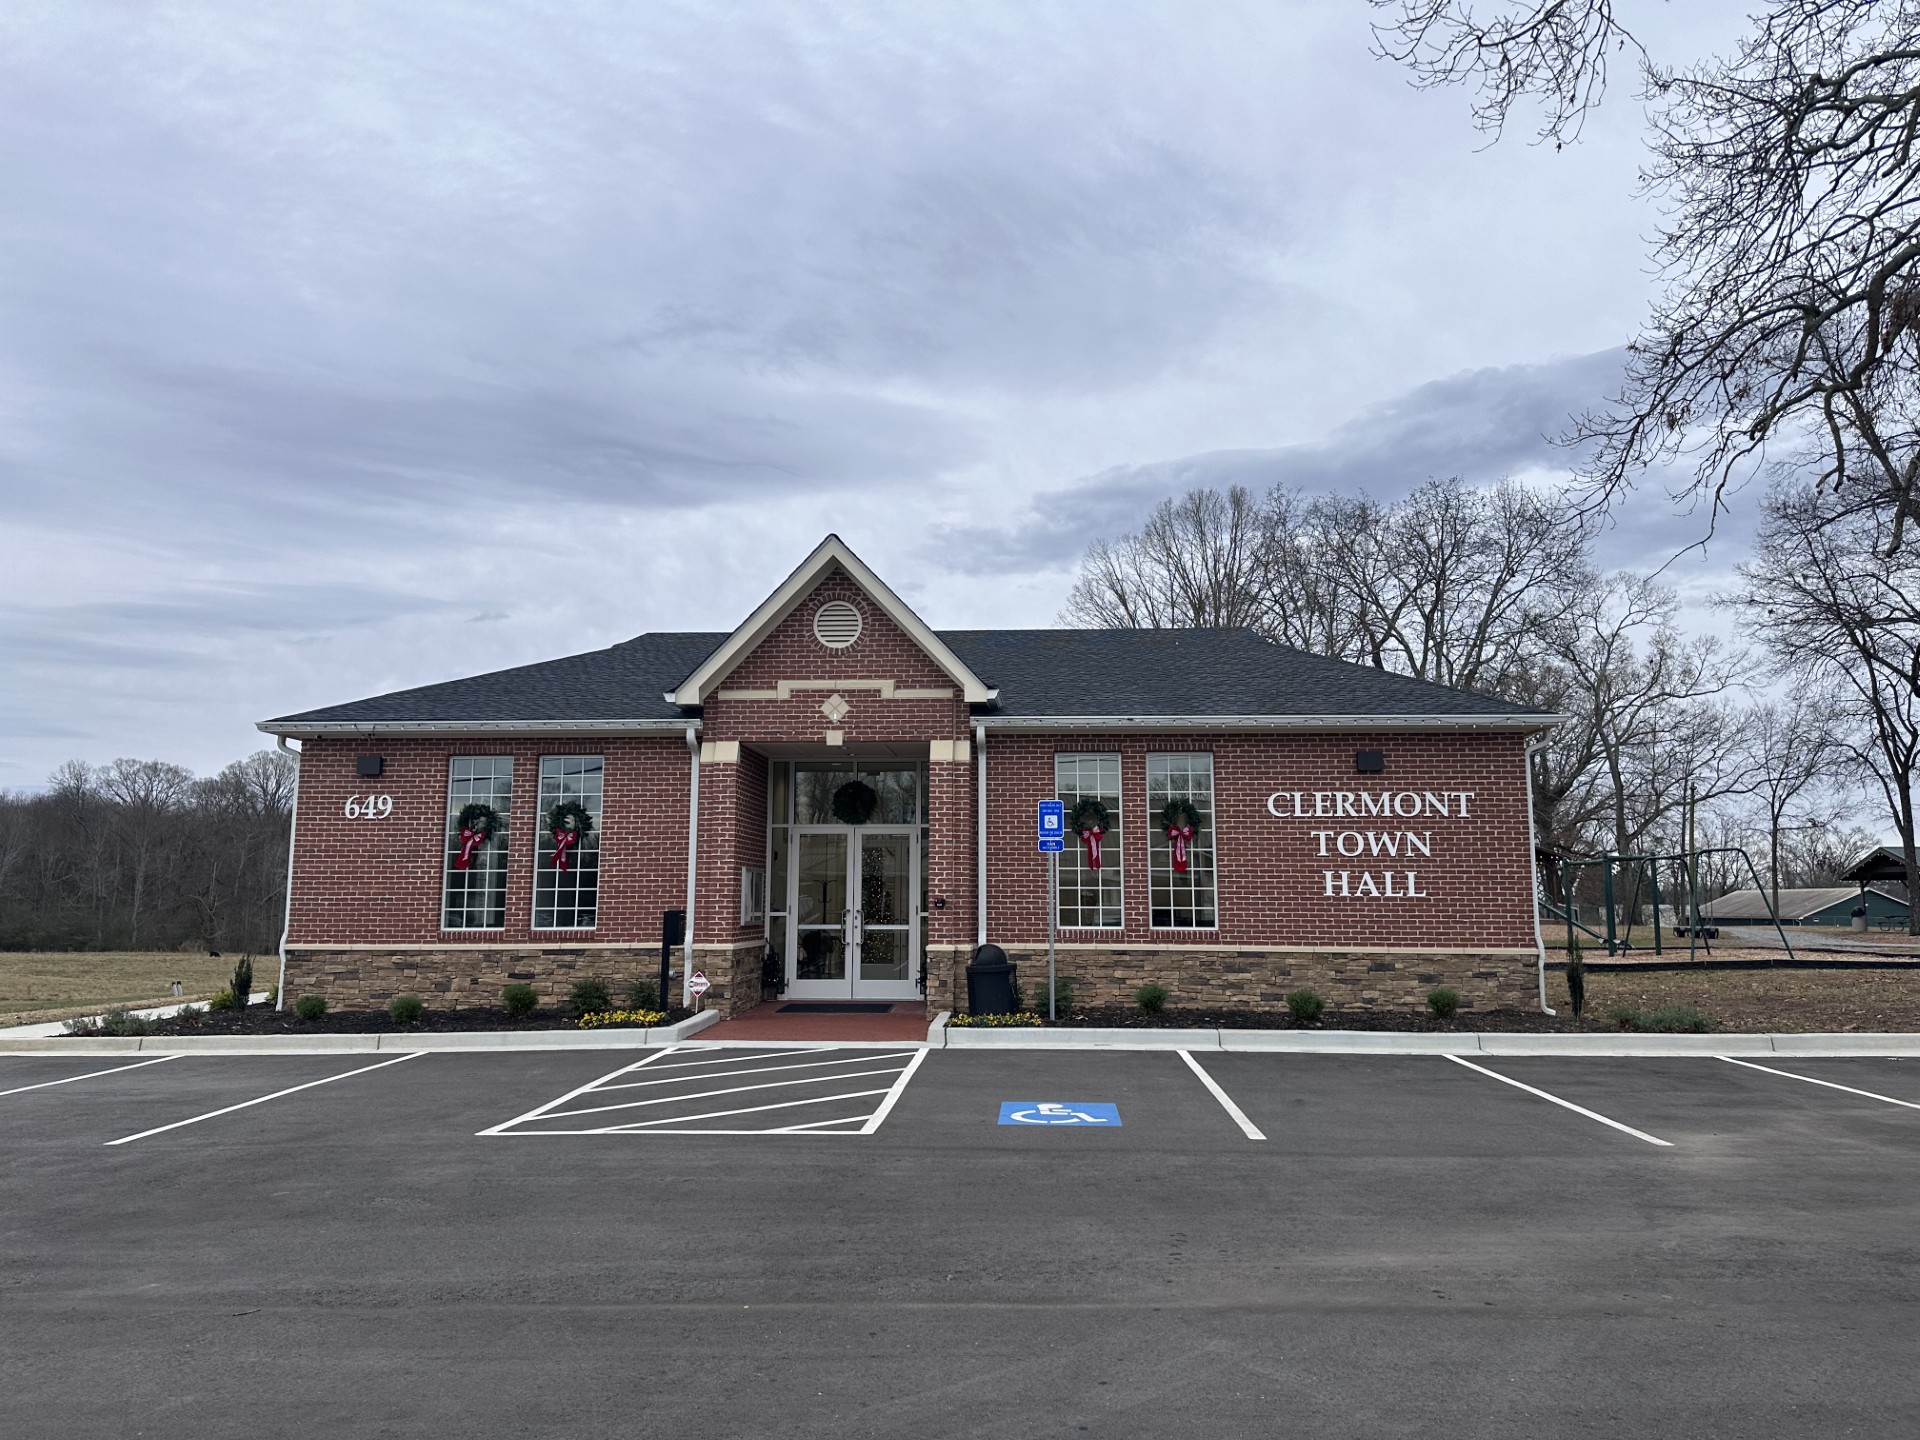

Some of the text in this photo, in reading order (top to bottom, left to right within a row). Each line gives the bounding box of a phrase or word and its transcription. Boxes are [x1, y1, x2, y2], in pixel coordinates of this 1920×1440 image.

[344, 795, 393, 819] 649
[1267, 791, 1475, 817] CLERMONT
[1310, 831, 1432, 857] TOWN
[1322, 870, 1427, 897] HALL
